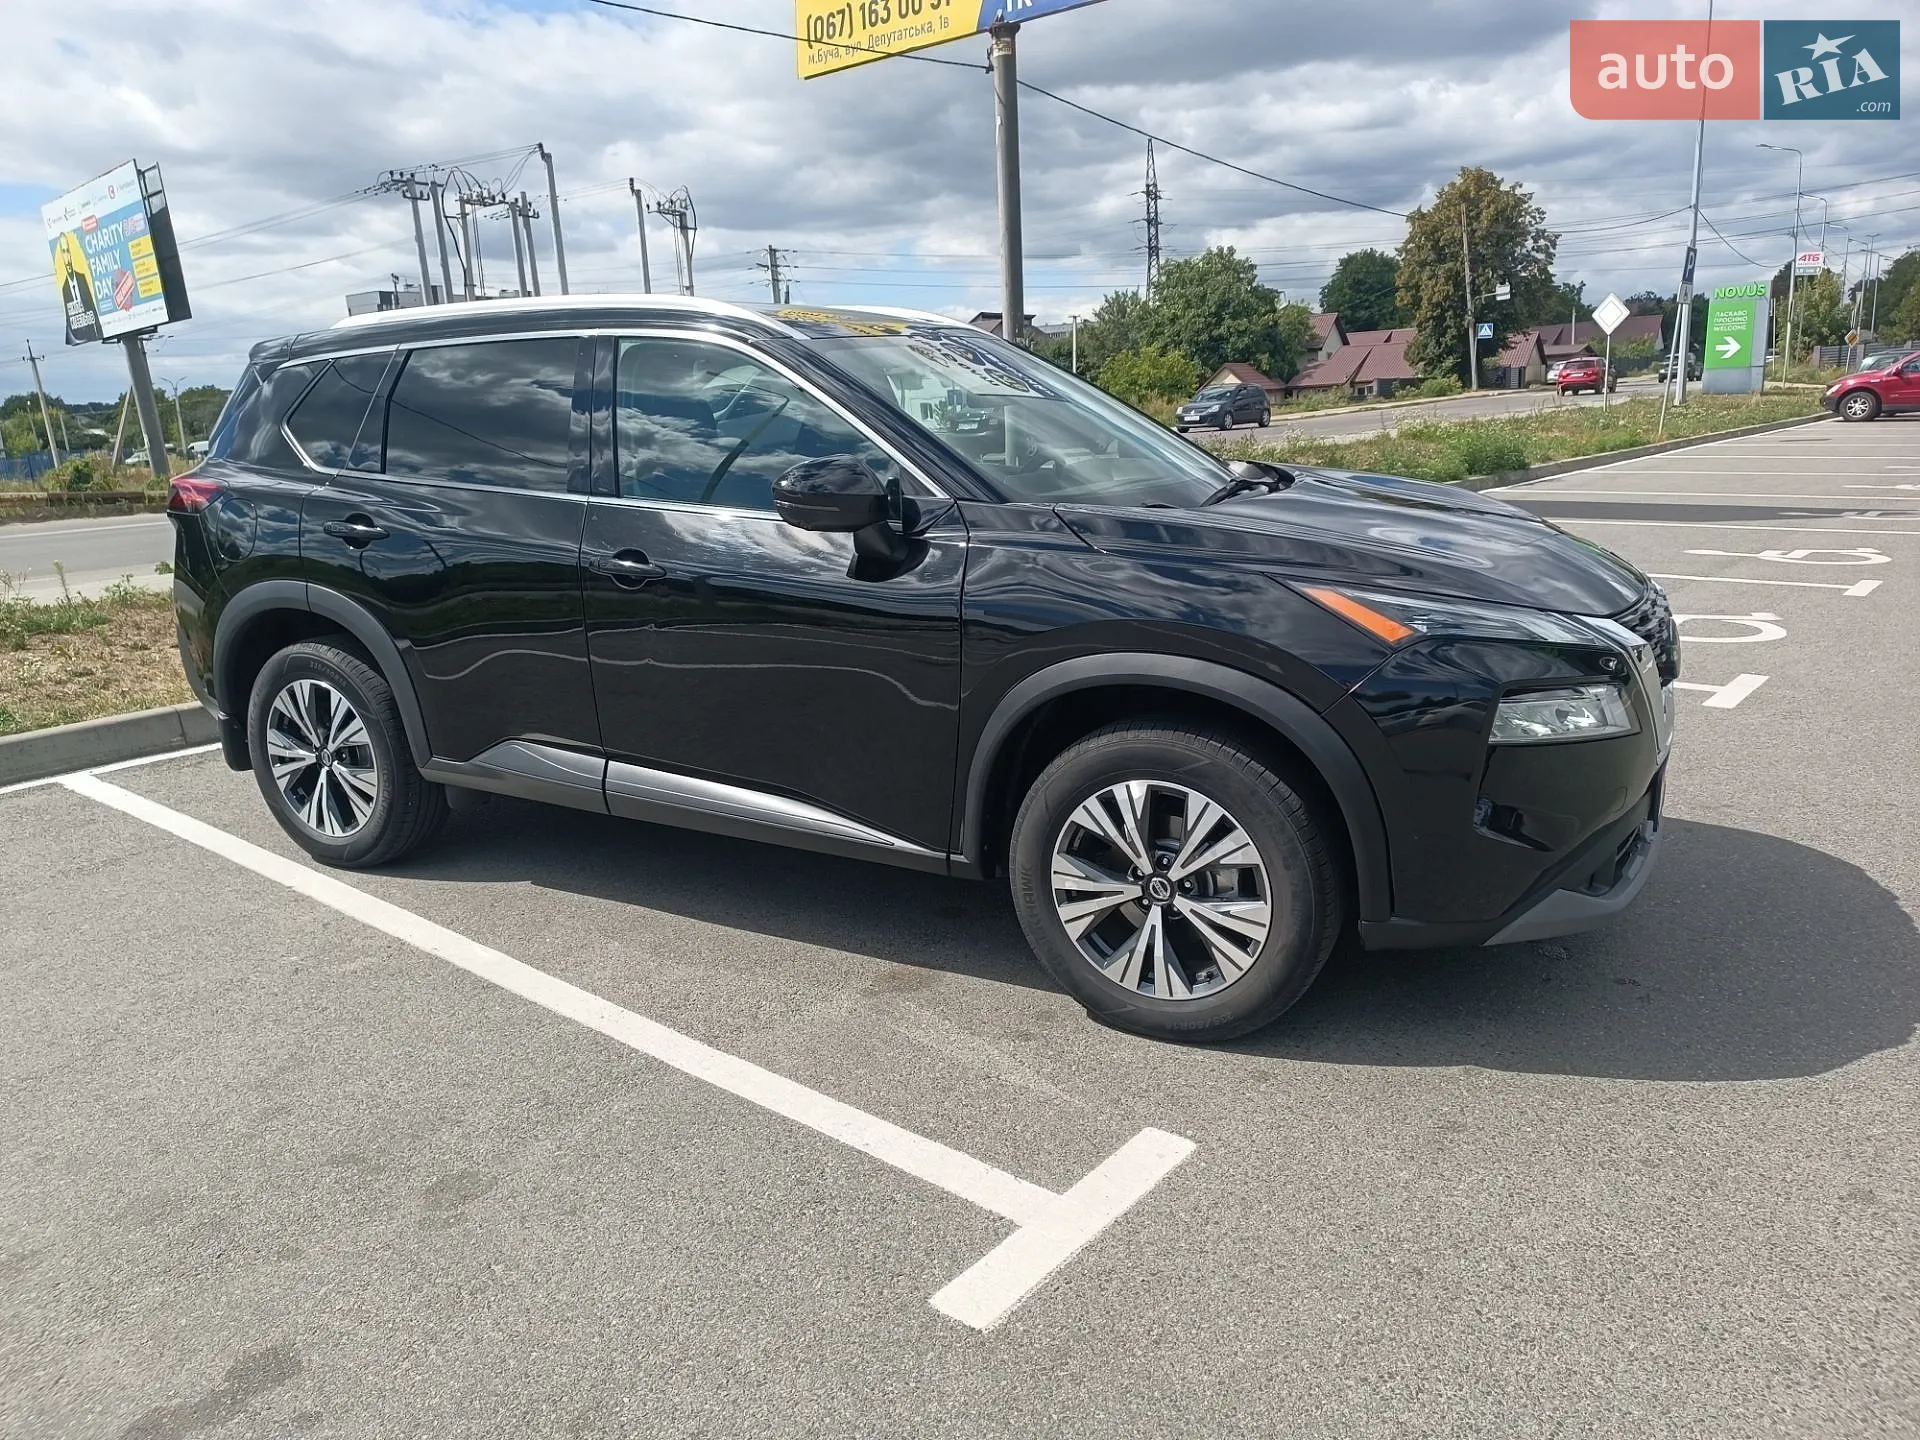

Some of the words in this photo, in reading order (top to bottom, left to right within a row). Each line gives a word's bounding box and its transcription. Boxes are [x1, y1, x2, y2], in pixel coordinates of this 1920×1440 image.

[807, 2, 853, 49] (067)
[859, 0, 891, 30] 163
[845, 41, 864, 57] вул
[868, 21, 936, 50] Депутатська,
[85, 222, 124, 254] CHARITY
[89, 249, 121, 278] FAMILY
[95, 276, 113, 299] DAY
[1714, 284, 1767, 299] NOVUS
